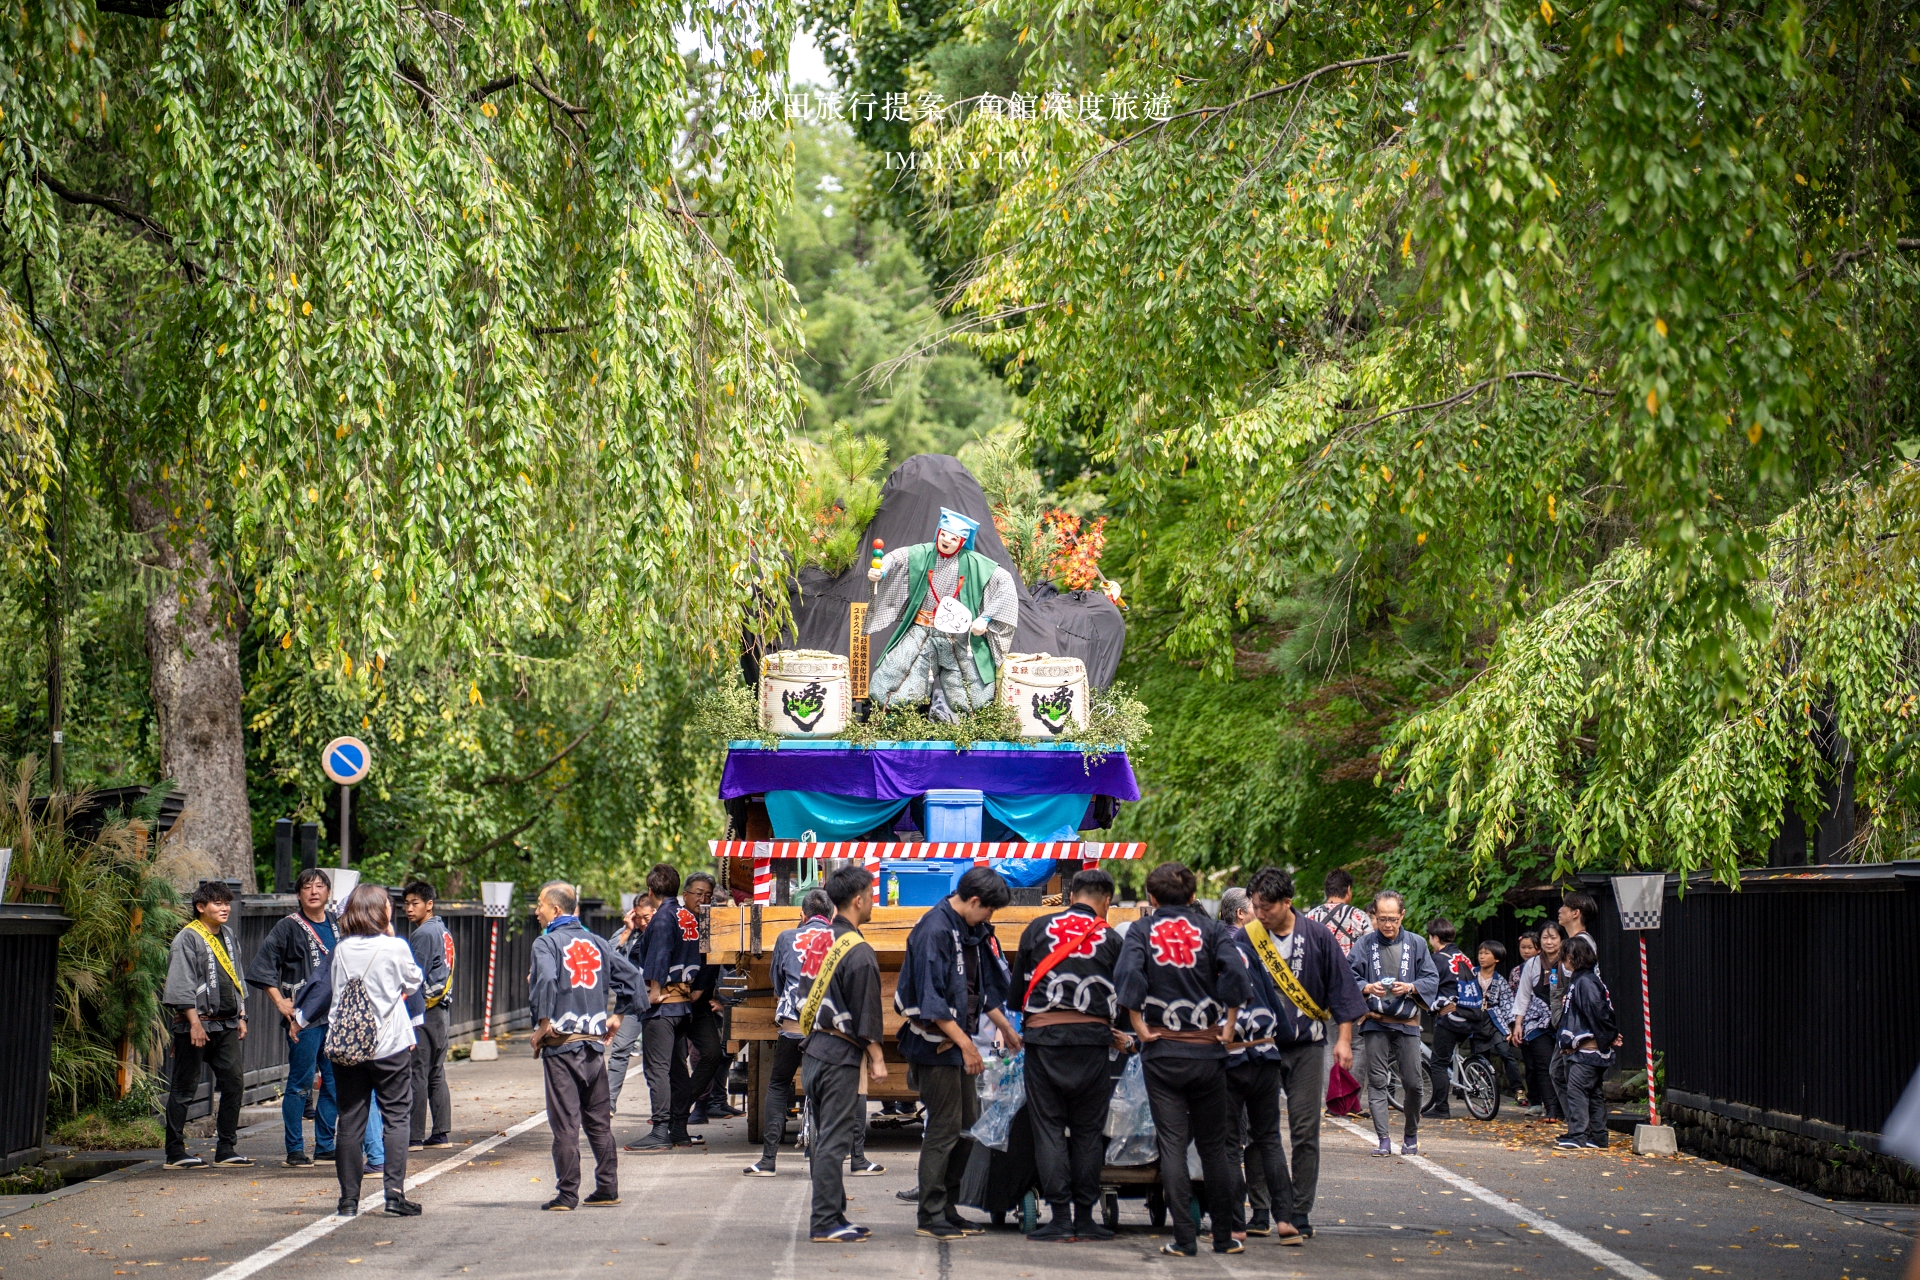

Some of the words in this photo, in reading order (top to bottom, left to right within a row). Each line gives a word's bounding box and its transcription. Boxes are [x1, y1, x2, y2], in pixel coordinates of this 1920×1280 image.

[1291, 934, 1305, 978] 中央通り
[1371, 943, 1381, 976] 中央通り
[1400, 943, 1411, 977] 中央通り
